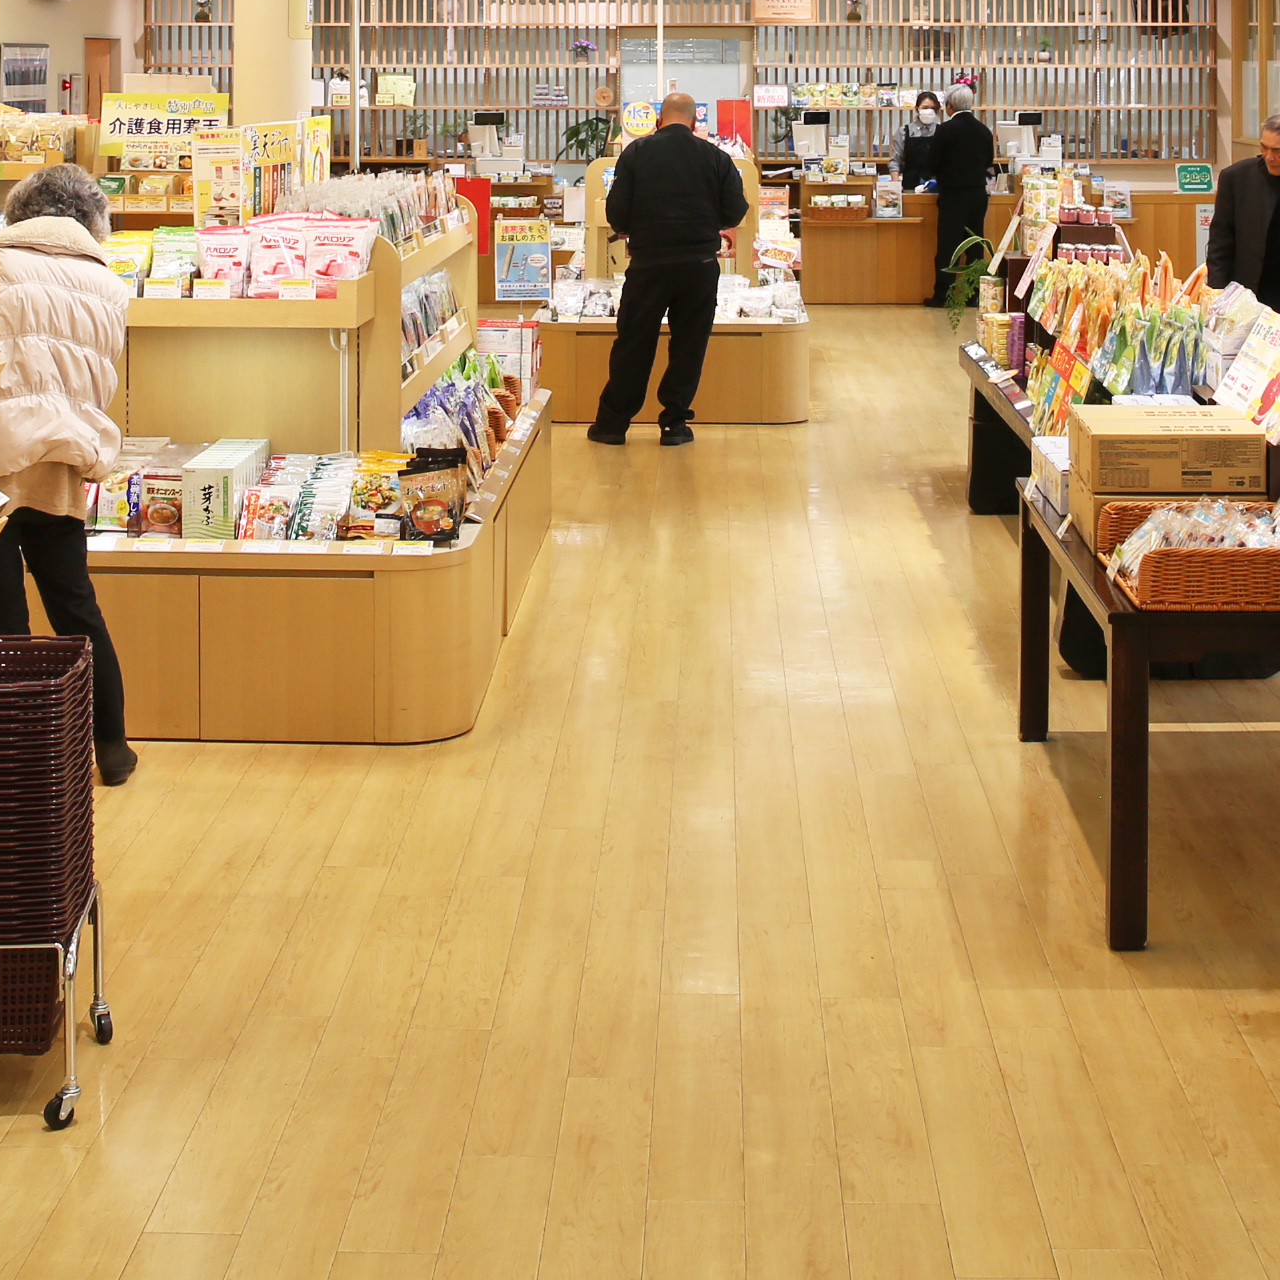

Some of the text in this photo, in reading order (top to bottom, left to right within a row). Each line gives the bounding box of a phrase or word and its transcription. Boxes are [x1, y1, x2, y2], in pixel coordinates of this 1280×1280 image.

[167, 99, 215, 114] 特別食品
[500, 234, 544, 242] お探しの方へ
[200, 484, 215, 526] 芽かぶ
